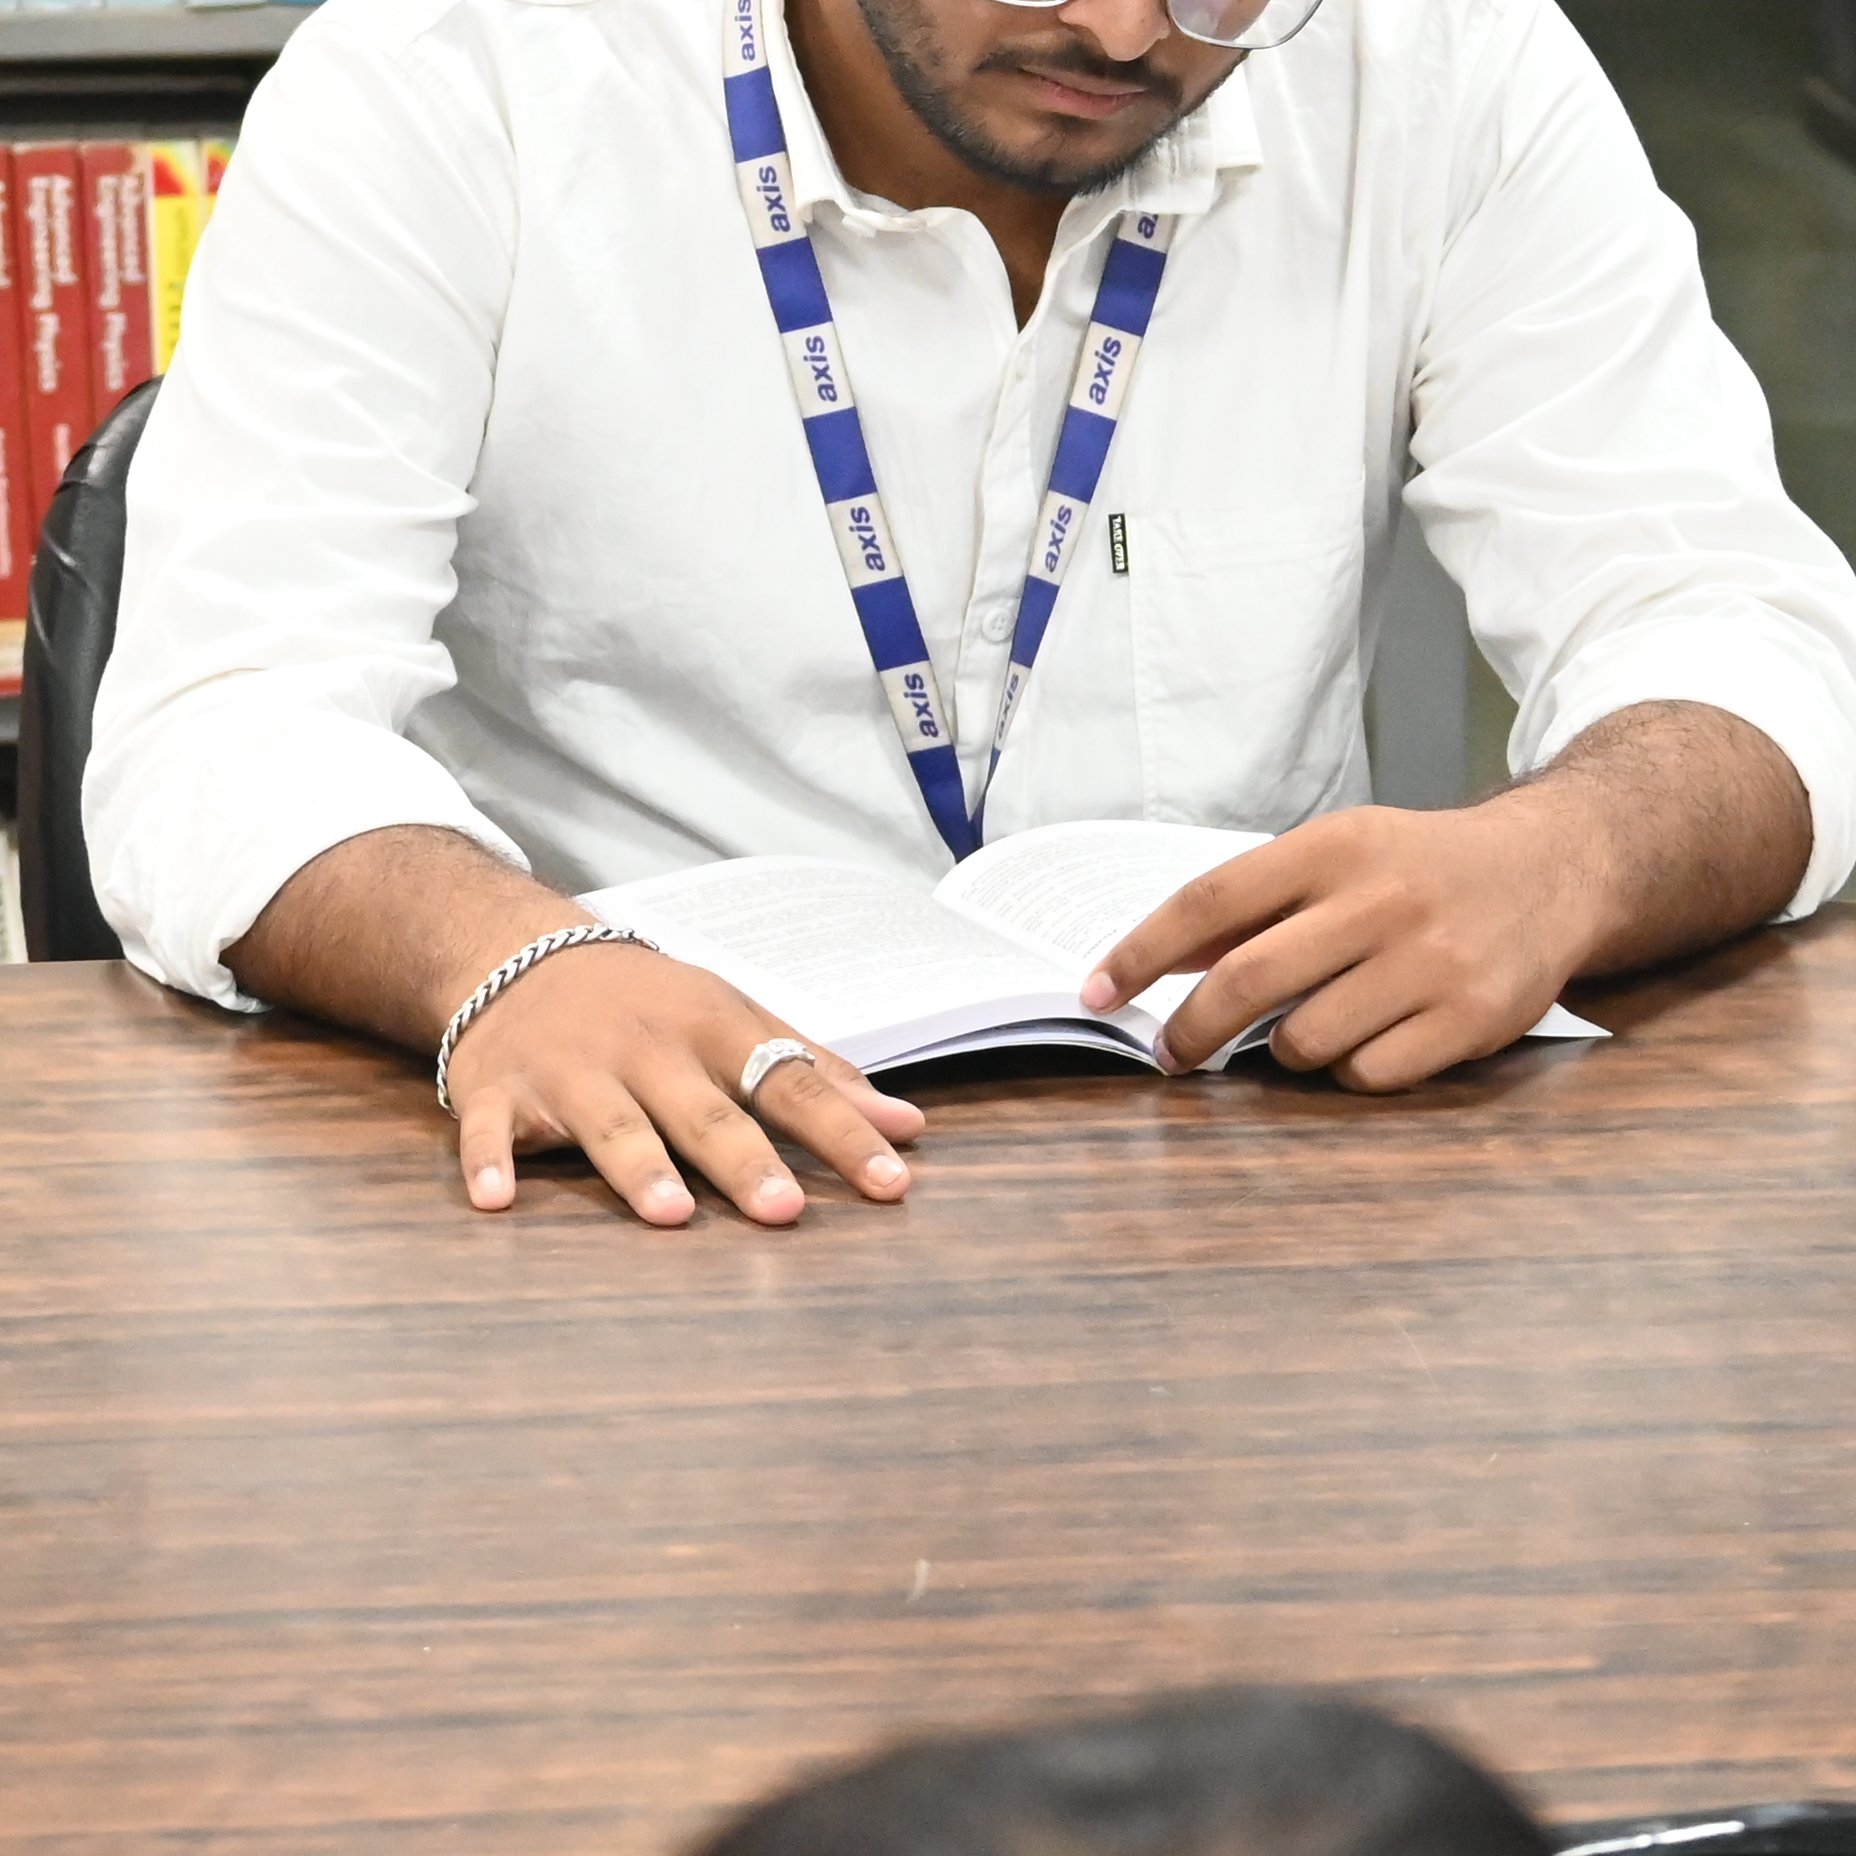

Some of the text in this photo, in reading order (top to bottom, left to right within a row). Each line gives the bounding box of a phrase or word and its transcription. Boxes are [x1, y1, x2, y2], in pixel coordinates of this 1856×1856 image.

[52, 176, 75, 283] Advanced
[121, 175, 144, 282] Advanced
[756, 165, 792, 233] axis
[27, 176, 60, 391] Engineering Physics
[97, 175, 127, 390] Engineering Physics
[802, 334, 838, 403] axis
[1088, 334, 1122, 406] axis
[848, 505, 886, 573] axis
[1044, 503, 1073, 573] axis
[1114, 544, 1125, 570] OVER
[903, 672, 939, 738] axis
[996, 672, 1020, 741] axis
